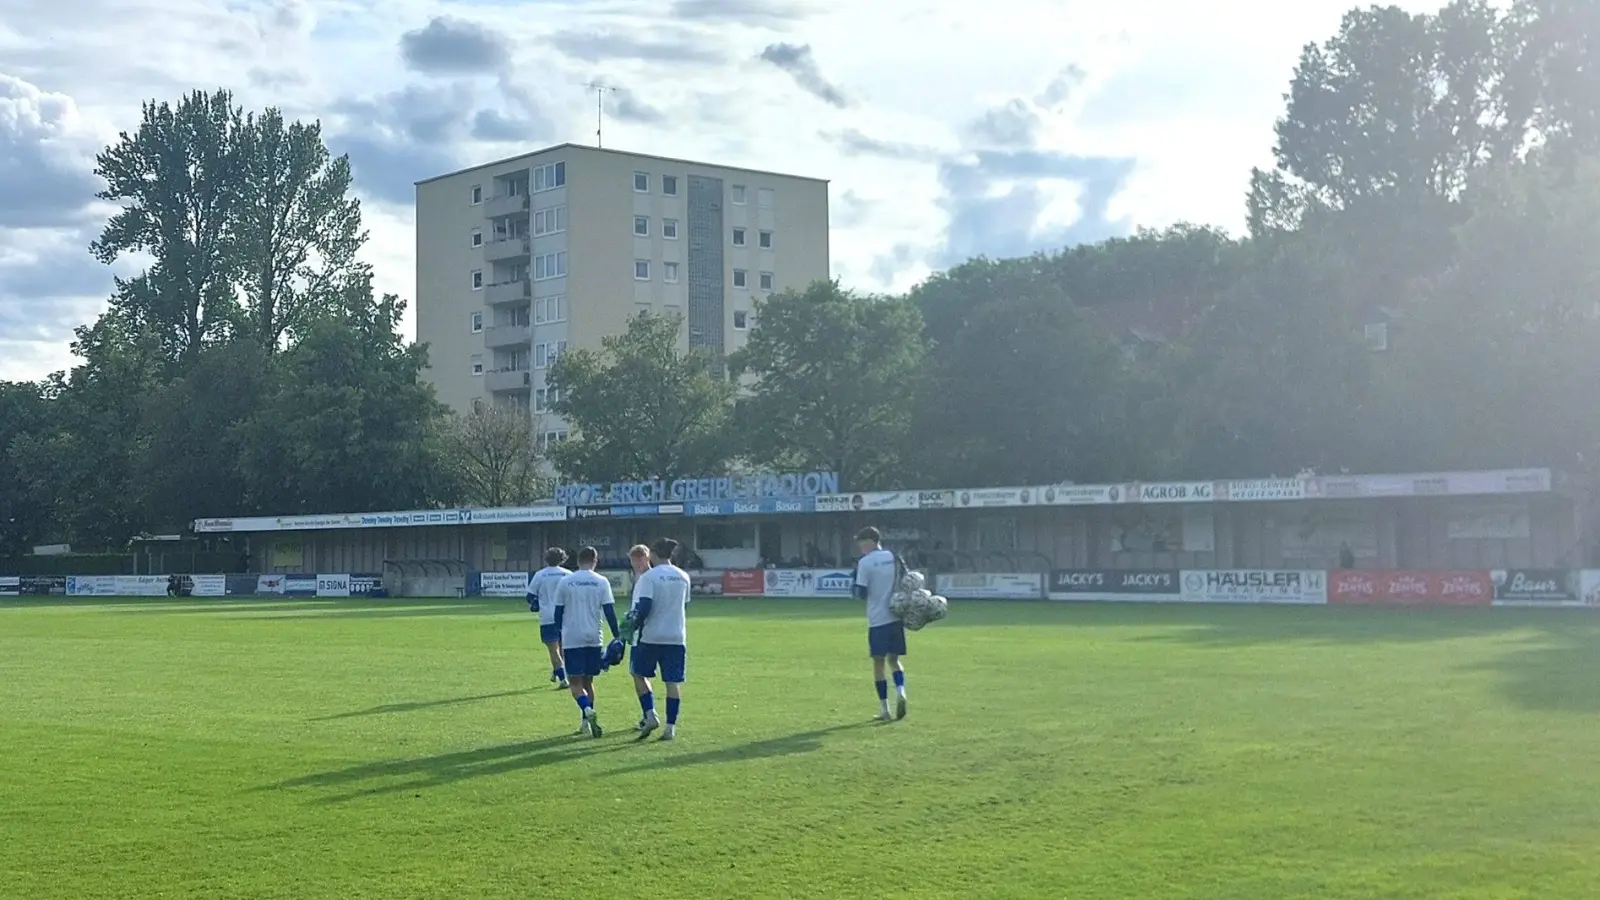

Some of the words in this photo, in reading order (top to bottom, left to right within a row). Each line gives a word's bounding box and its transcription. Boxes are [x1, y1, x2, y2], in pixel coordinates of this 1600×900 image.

[610, 480, 667, 503] ERICH
[671, 477, 735, 501] GREIPL
[1142, 485, 1186, 499] AGROB
[1191, 484, 1210, 498] AG
[694, 503, 719, 514] Basica
[734, 501, 760, 513] Basica
[775, 500, 802, 511] Basica
[326, 580, 348, 590] SIGNA
[1057, 572, 1104, 586] JACKY'S
[1122, 572, 1170, 586] JACKY'S
[1206, 572, 1300, 586] HÄUSLER
